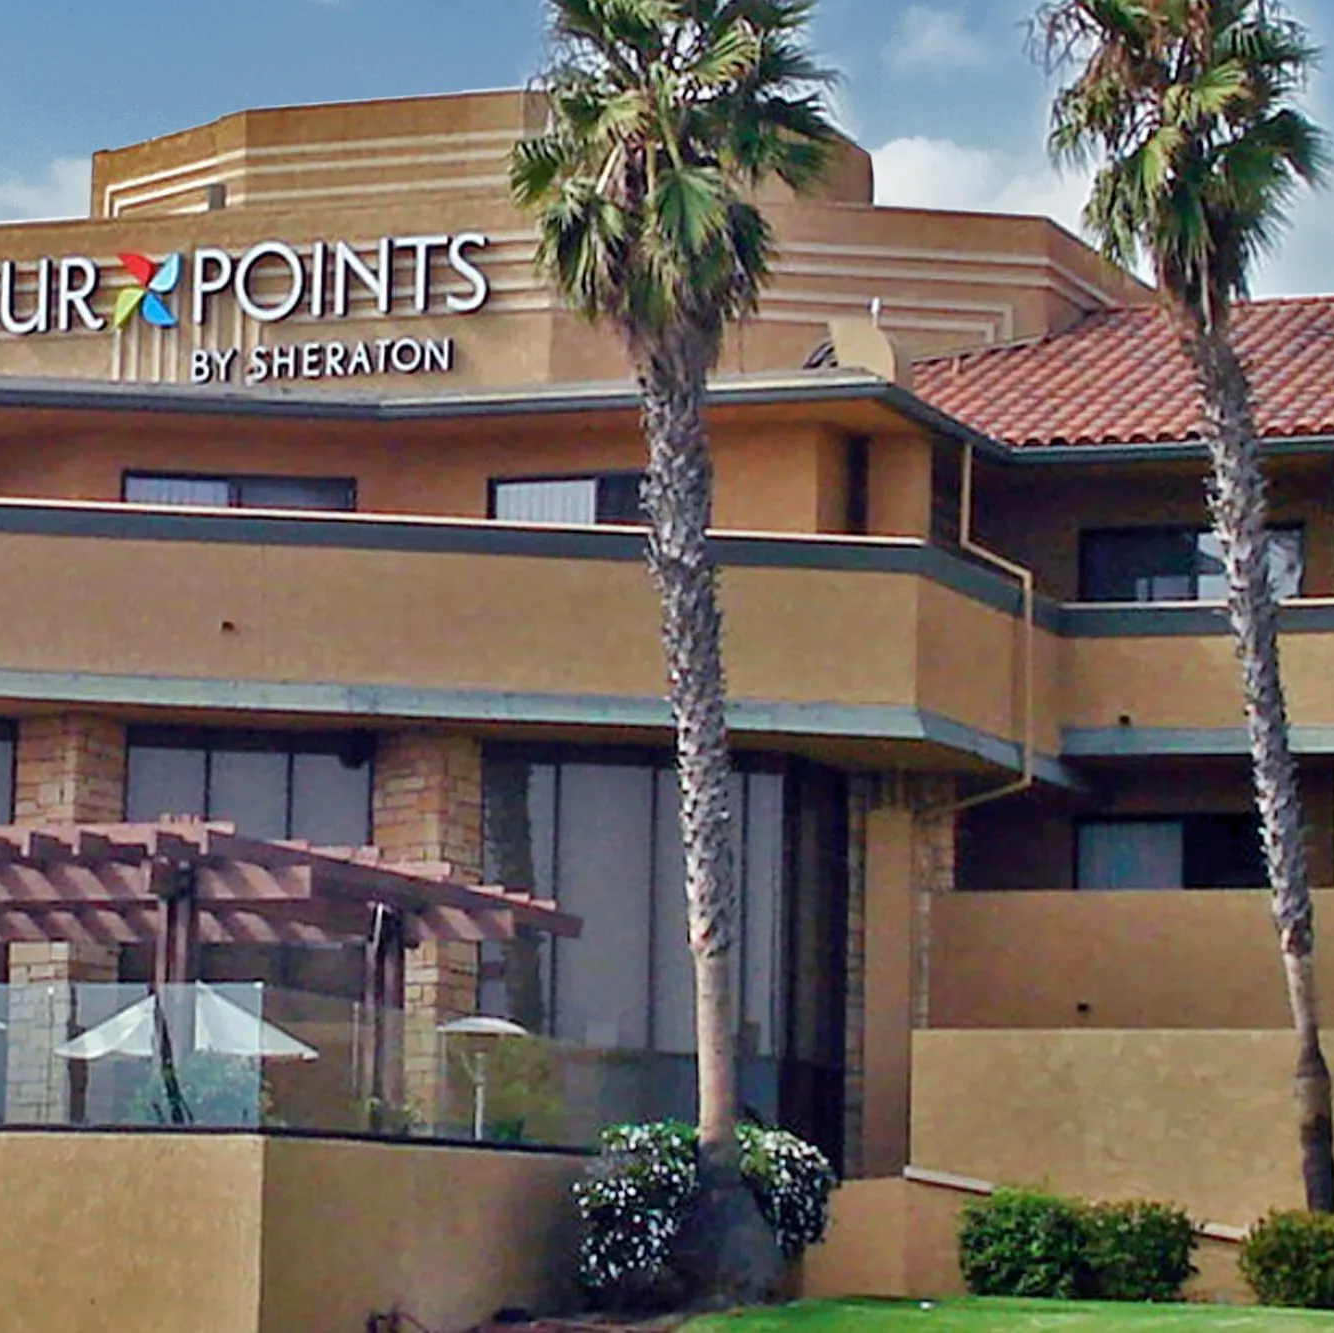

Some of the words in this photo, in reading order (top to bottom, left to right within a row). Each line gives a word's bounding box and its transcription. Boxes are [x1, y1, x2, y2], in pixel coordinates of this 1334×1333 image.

[193, 231, 489, 324] POINTS
[190, 347, 238, 383] BY
[246, 336, 454, 385] SHERATON
